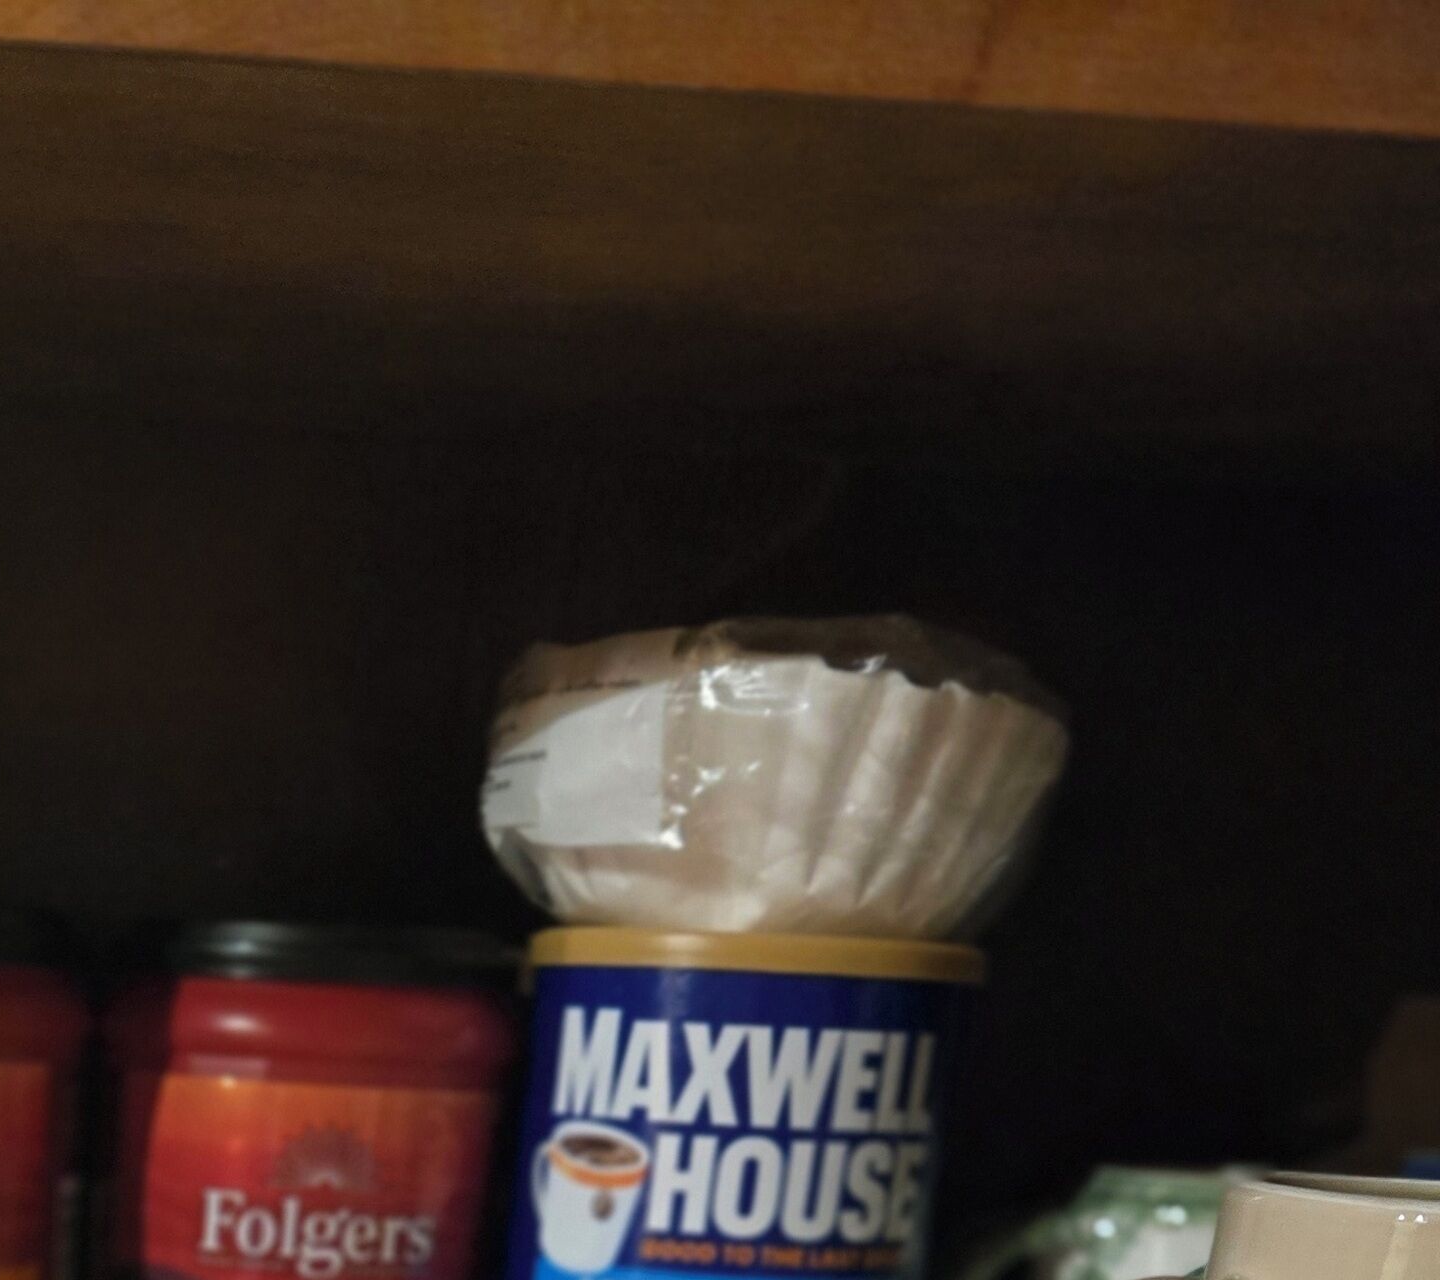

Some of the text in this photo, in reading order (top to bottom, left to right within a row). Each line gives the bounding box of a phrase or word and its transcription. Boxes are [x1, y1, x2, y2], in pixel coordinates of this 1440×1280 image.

[552, 1005, 938, 1133] MAXWELL
[196, 1186, 436, 1280] Folgers
[644, 1132, 929, 1244] HOUSE
